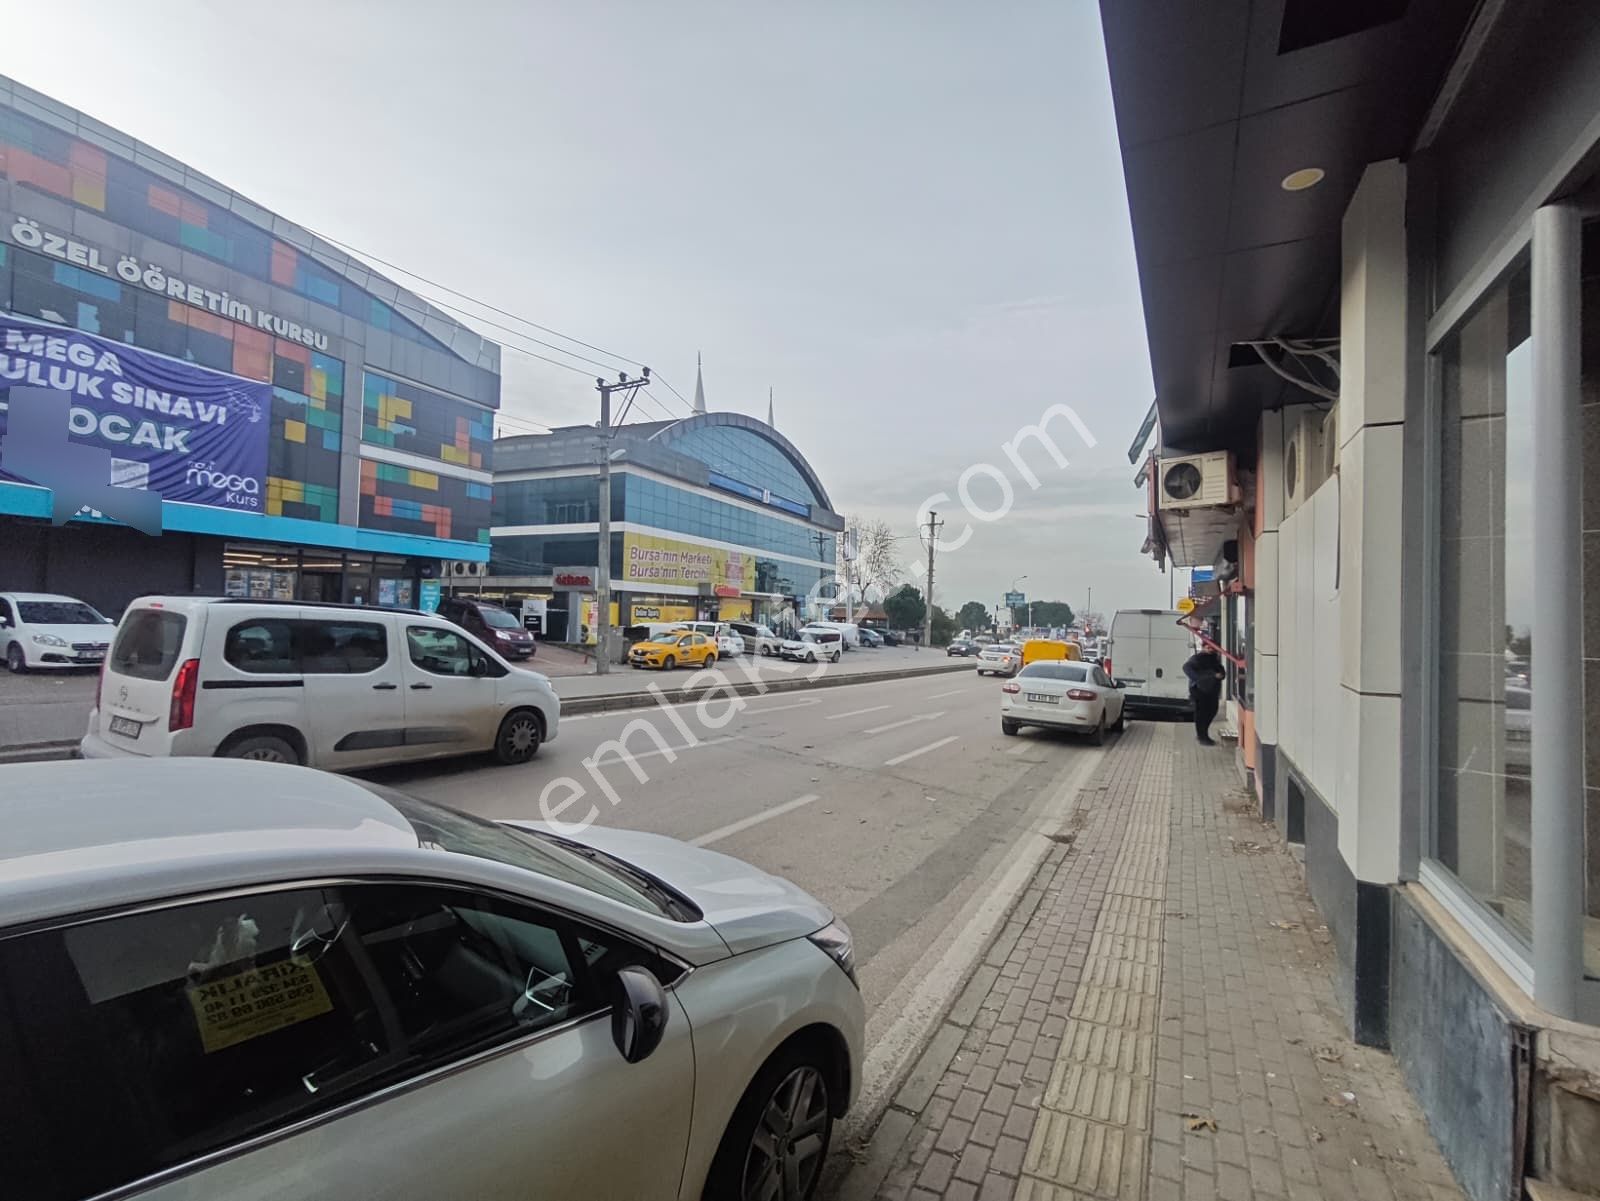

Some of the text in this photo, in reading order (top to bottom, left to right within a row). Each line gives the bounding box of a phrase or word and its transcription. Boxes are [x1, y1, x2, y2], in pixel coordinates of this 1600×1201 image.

[10, 216, 109, 273] ÖZEL
[257, 310, 329, 351] KURSU
[5, 329, 123, 377] MEGA
[111, 382, 227, 426] SINAVI
[68, 406, 191, 453] OCAK
[226, 491, 258, 507] Kurs
[680, 551, 712, 565] Marketi
